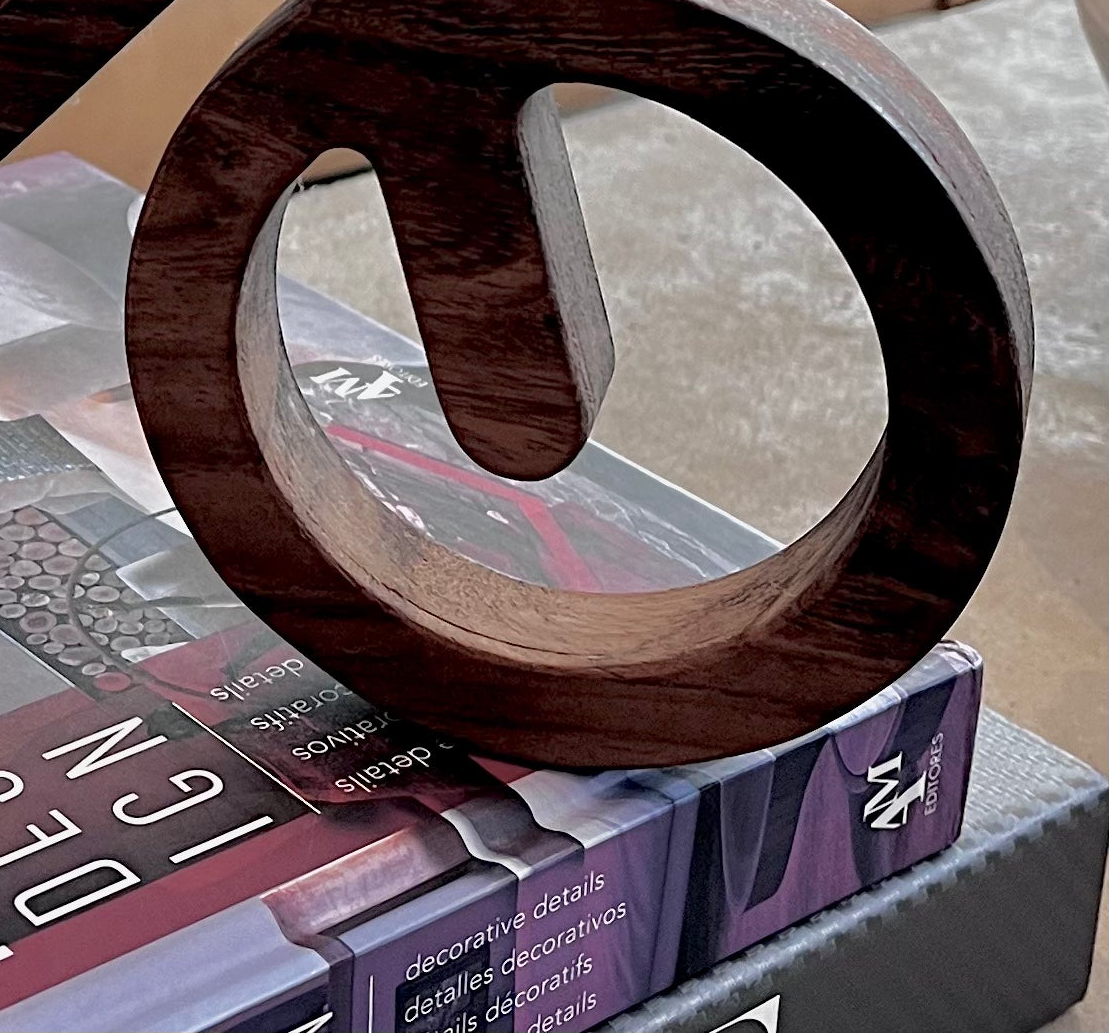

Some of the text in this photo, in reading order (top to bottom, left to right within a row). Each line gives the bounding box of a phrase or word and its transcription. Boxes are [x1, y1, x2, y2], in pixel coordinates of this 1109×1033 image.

[210, 658, 304, 701] details
[41, 716, 274, 864] IGN
[334, 746, 431, 793] details
[924, 732, 944, 816] EDITORES
[405, 901, 627, 1022] detalles decorativos
[406, 870, 605, 981] decorative details
[486, 953, 593, 1022] décoratifs
[528, 991, 597, 1033] details
